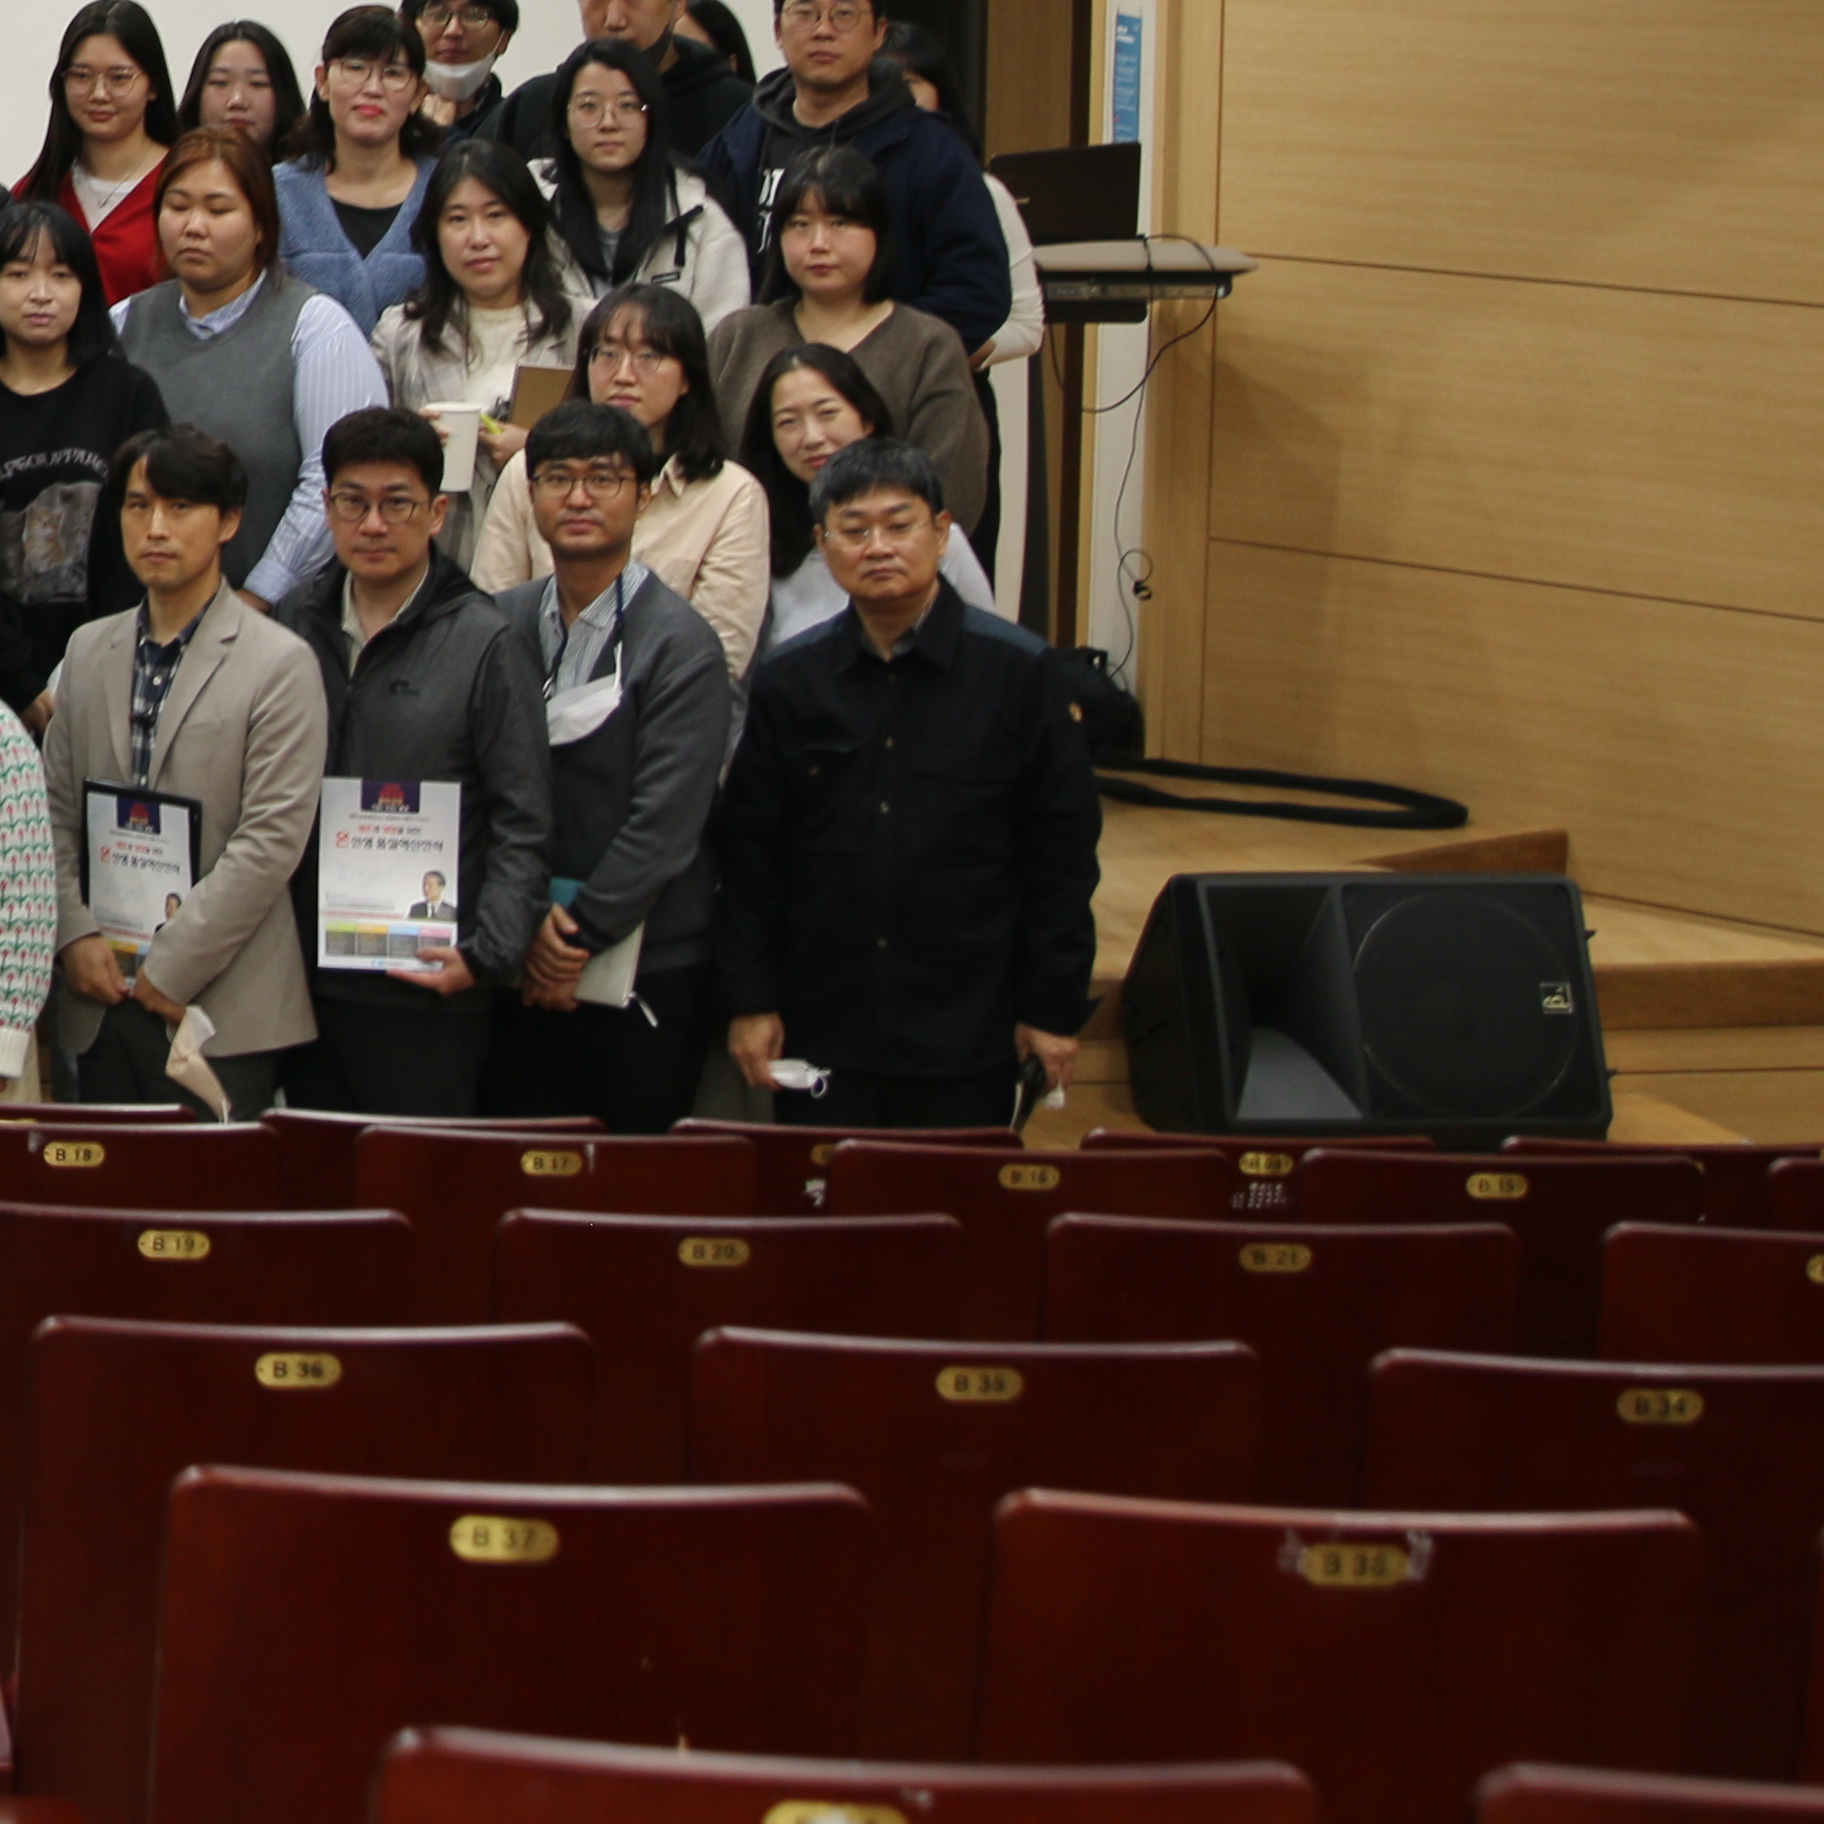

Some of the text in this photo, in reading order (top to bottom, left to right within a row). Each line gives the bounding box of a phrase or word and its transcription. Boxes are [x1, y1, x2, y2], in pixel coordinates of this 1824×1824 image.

[56, 1148, 91, 1161] B 18
[153, 1237, 195, 1251] B 19
[274, 1361, 323, 1378] B 36
[1635, 1397, 1684, 1415] B 34
[472, 1526, 533, 1547] B 37
